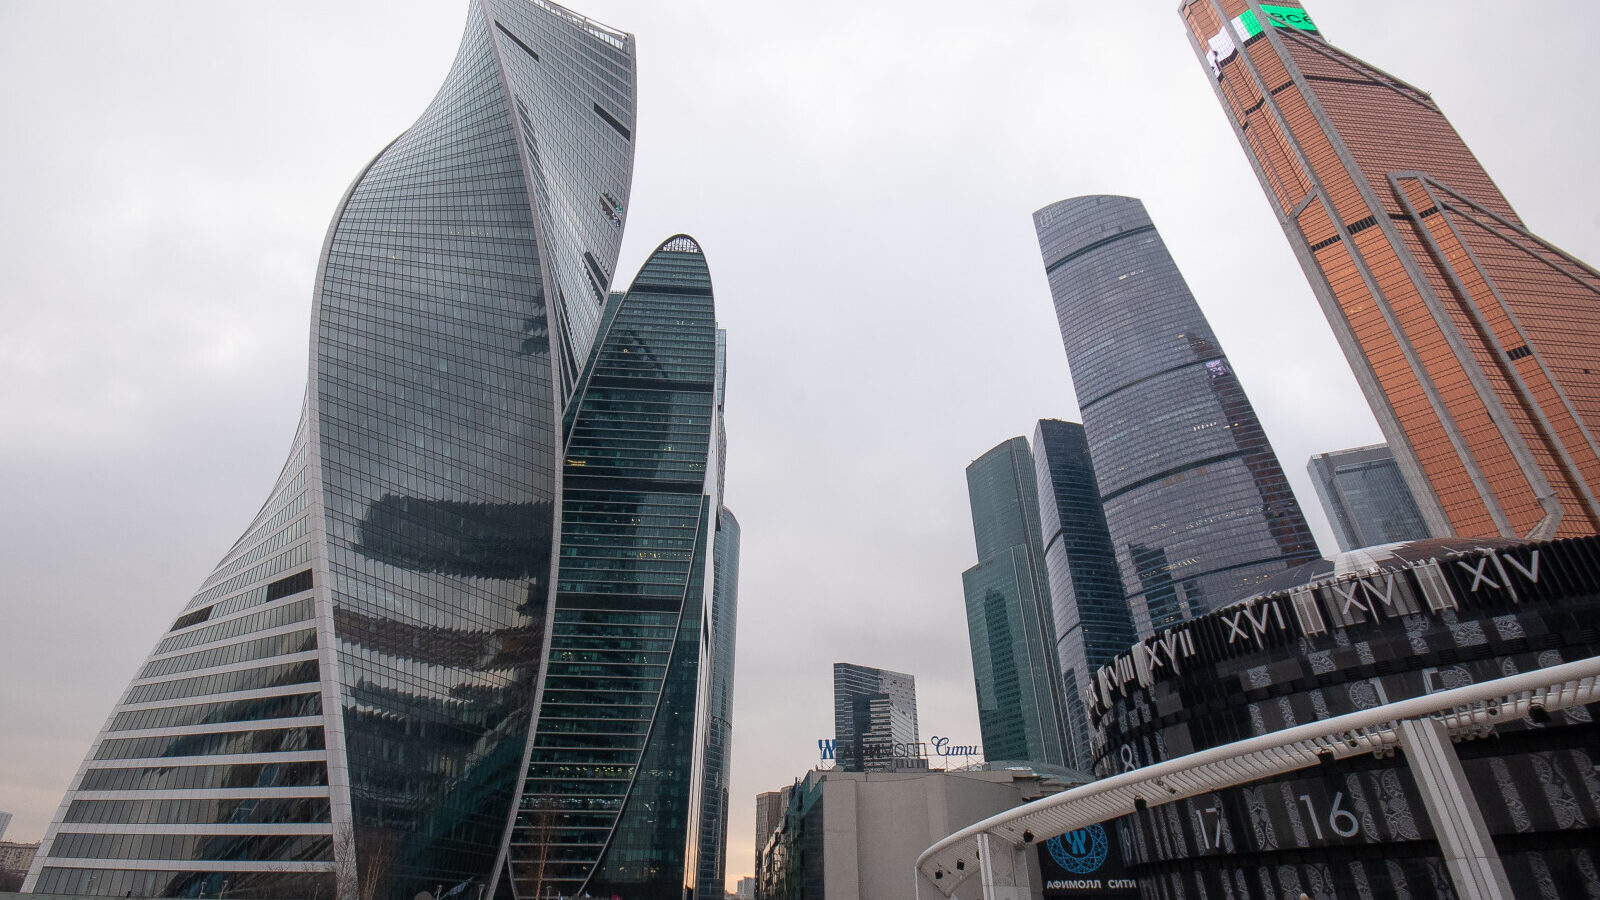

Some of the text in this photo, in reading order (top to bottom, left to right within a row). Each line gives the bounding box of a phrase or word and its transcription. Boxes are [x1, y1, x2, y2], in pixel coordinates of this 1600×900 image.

[1221, 601, 1286, 644] XVI
[1195, 806, 1222, 850] 17
[1299, 791, 1359, 840] 16
[1046, 879, 1137, 890] АФИМОЛЛ СИТИ
